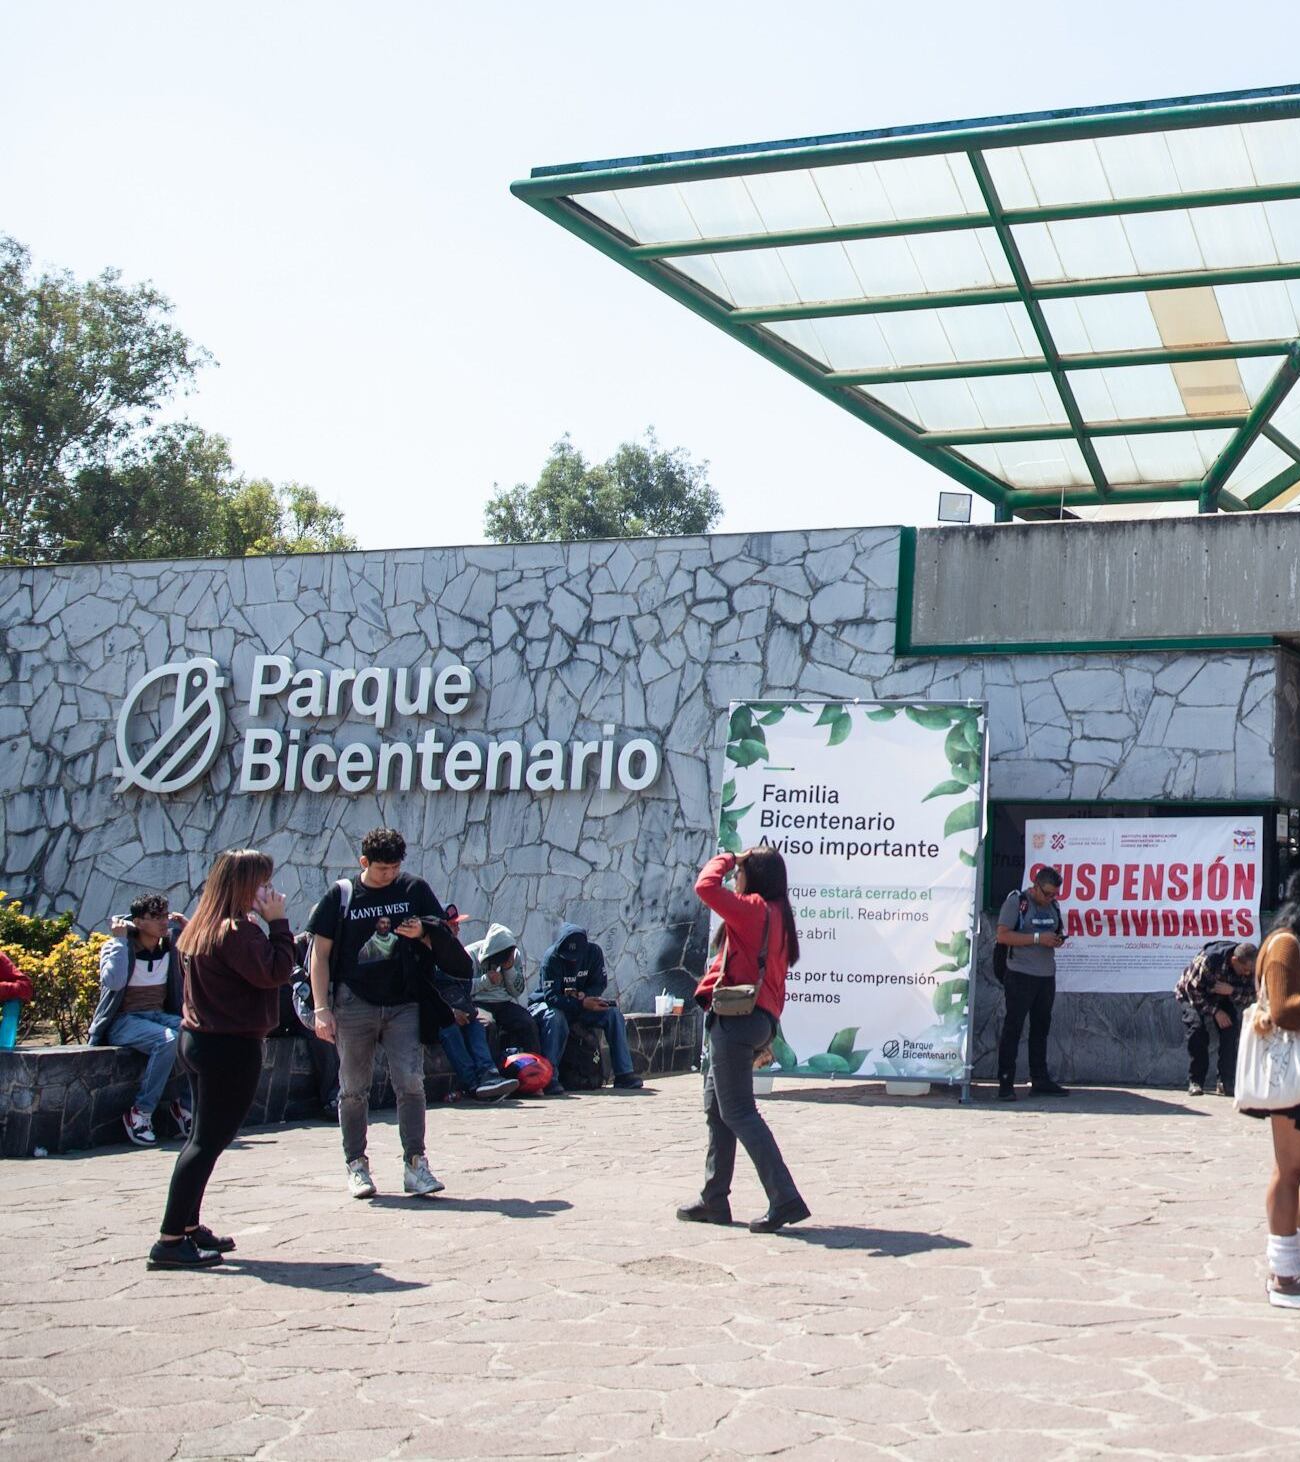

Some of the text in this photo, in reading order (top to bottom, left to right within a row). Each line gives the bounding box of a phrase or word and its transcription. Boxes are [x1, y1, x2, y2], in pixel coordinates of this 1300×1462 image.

[248, 654, 478, 729] Parque
[239, 723, 664, 793] Bicentenario
[762, 784, 840, 804] Familia
[760, 809, 895, 831] Bicentenario
[819, 836, 940, 861] importante
[787, 886, 932, 901] rque estará cerrado el
[350, 902, 410, 920] KANYE WEST
[800, 906, 816, 918] de
[819, 907, 854, 920] abril.
[858, 908, 929, 922] Reabrimos
[1067, 908, 1254, 938] ACTIVIDADES
[806, 927, 837, 940] abril
[804, 971, 827, 984] por
[830, 970, 843, 983] tu
[847, 970, 940, 987] comprensión,
[903, 1040, 934, 1050] Parque
[902, 1050, 957, 1060] Bicentenario
